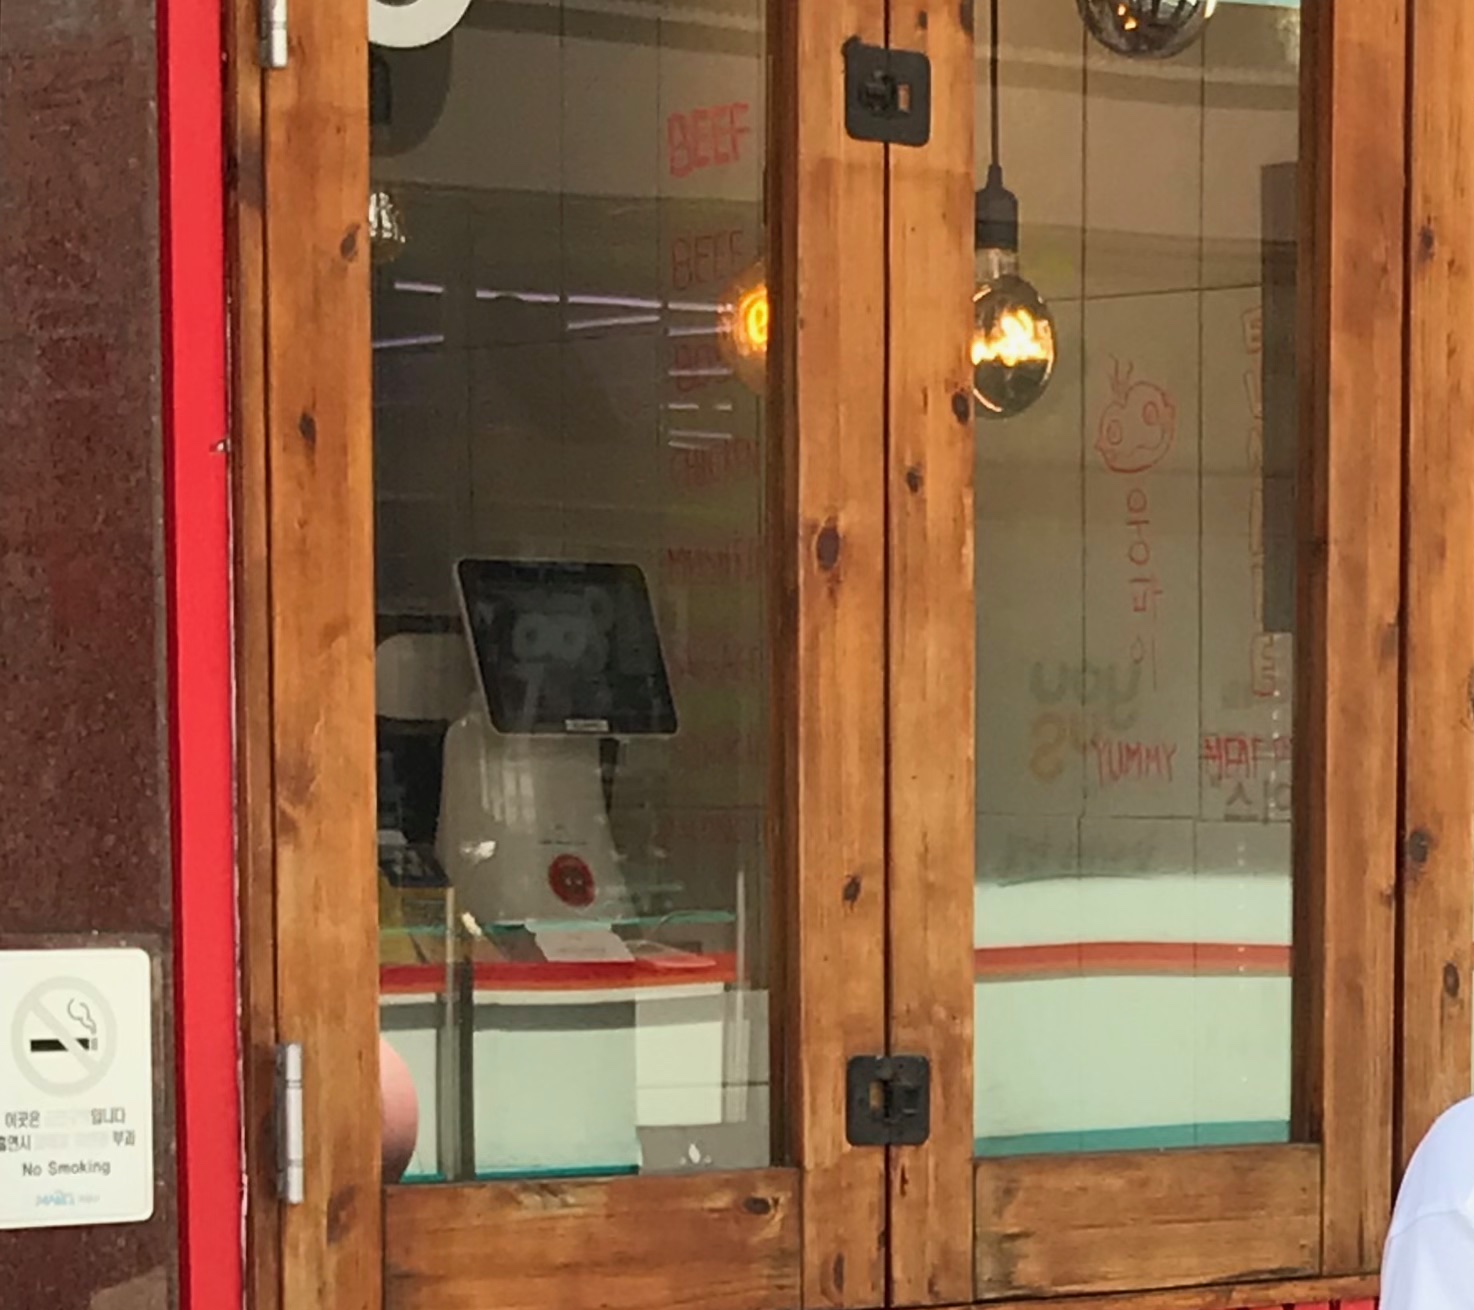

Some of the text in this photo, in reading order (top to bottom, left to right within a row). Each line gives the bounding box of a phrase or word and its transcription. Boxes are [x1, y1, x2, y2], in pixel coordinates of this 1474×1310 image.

[667, 102, 750, 178] BEEF
[1091, 735, 1177, 786] YUMMY
[22, 1160, 112, 1177] No Smoking
